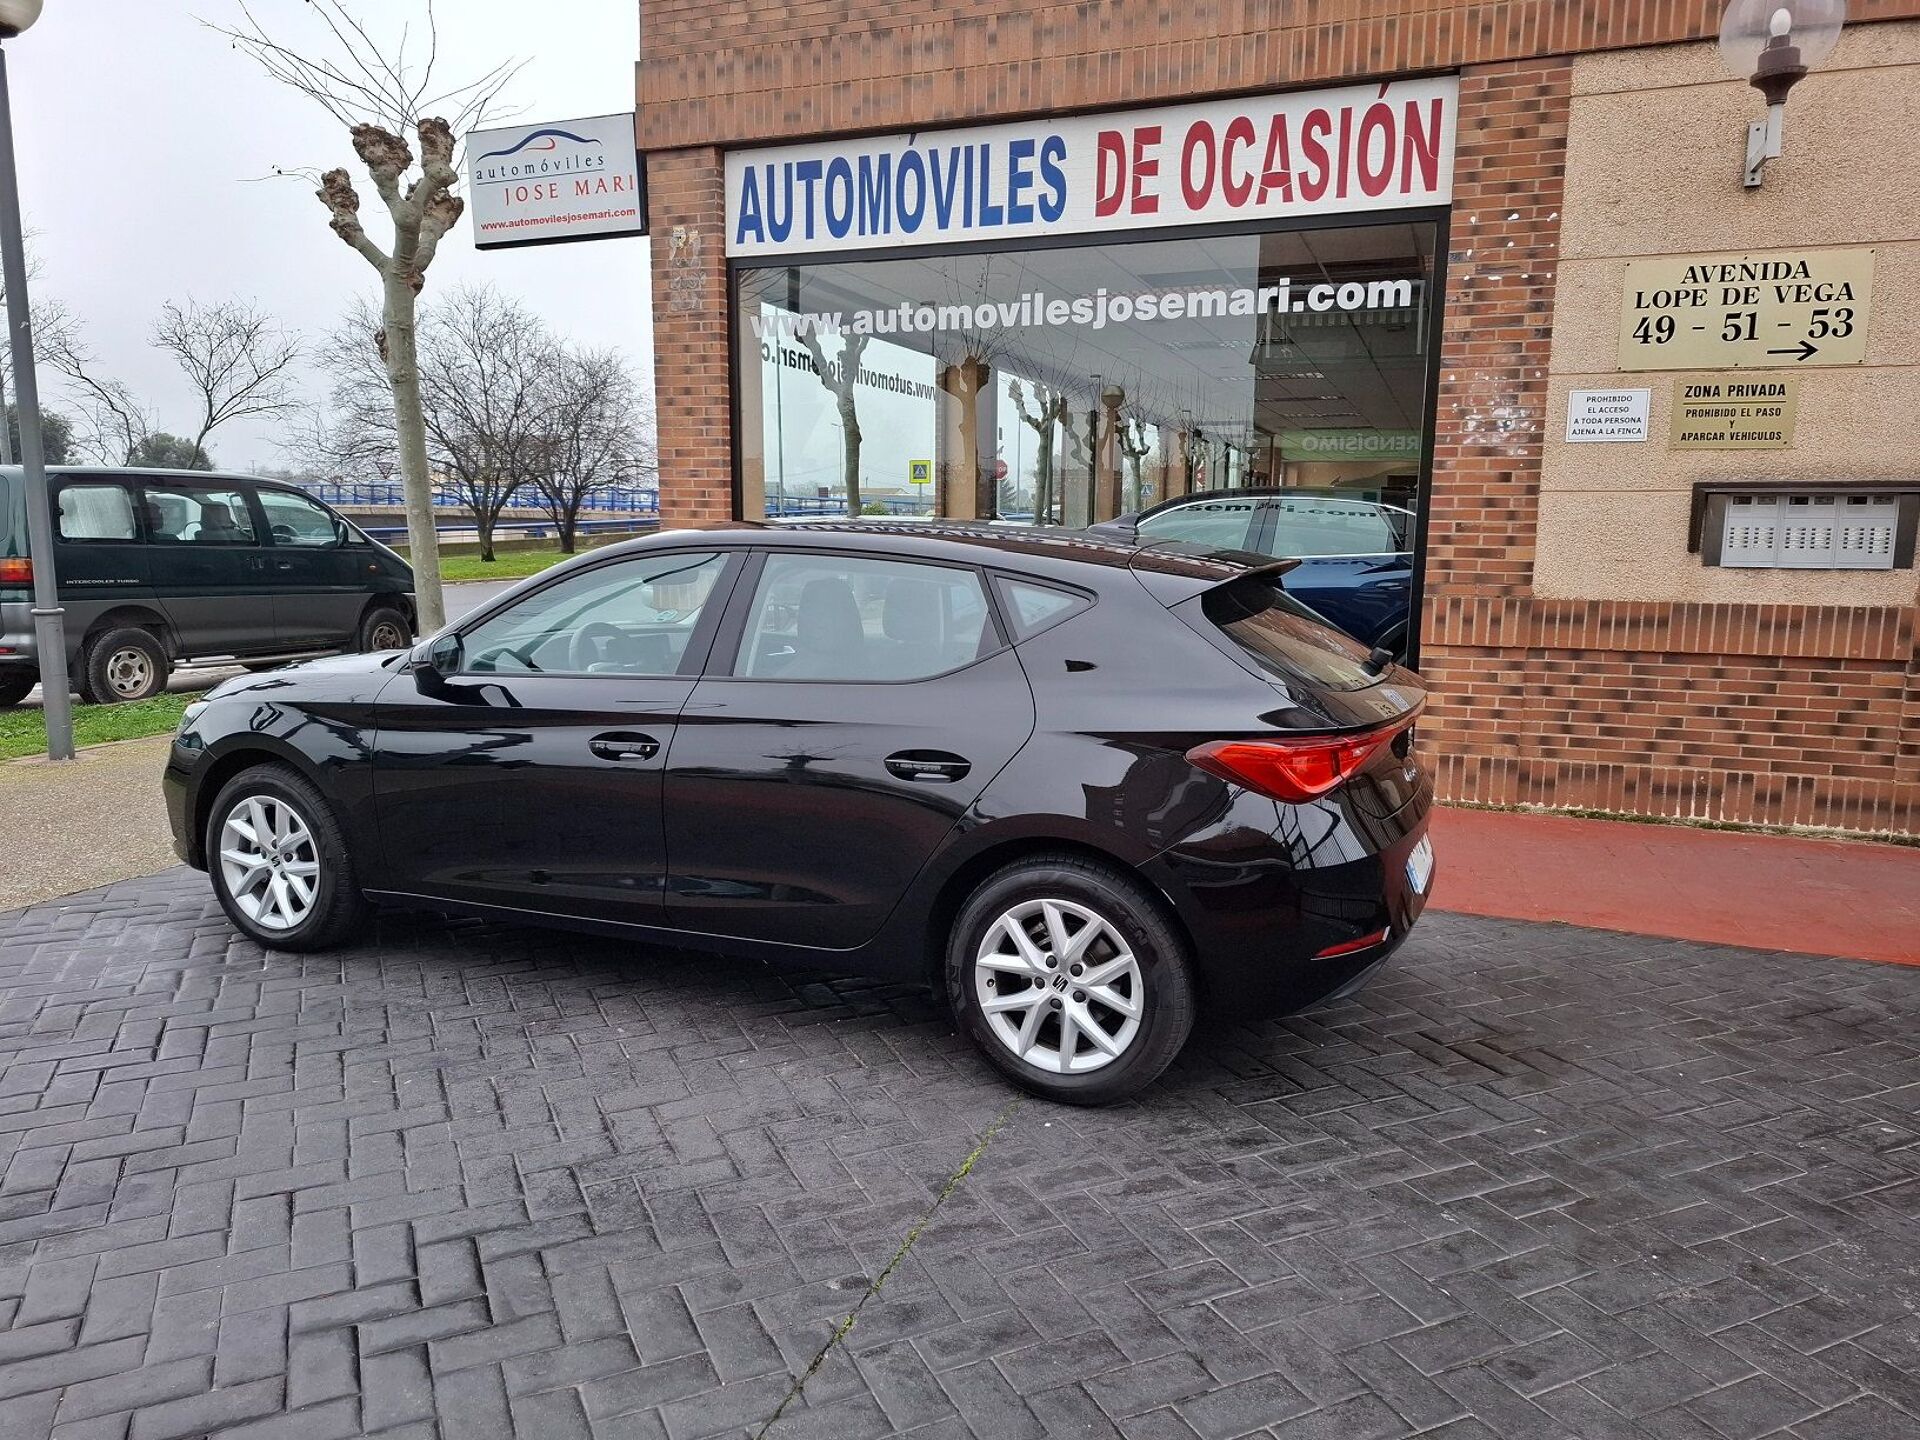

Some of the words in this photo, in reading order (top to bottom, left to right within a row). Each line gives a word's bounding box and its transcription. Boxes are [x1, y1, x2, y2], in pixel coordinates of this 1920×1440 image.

[475, 154, 605, 180] automóviles
[736, 132, 1067, 244] AUTOMÓVILES
[1095, 126, 1163, 218] DE
[1181, 82, 1444, 211] OCASIÓN
[505, 183, 559, 206] JOSE
[575, 174, 634, 196] MARI
[481, 208, 636, 231] www.automovilesjosemari.com
[1681, 260, 1811, 284] AVENIDA
[750, 276, 1413, 339] www.automovilesjosemari.com
[1634, 289, 1708, 309] LOPE
[1721, 286, 1761, 306] DE
[1774, 282, 1855, 304] VEGA
[1632, 315, 1676, 345] 49
[1721, 312, 1760, 342] 51
[1807, 308, 1854, 339] 53
[1586, 395, 1633, 403] PROHIBIDO
[1684, 385, 1720, 398] ZONA
[1728, 384, 1786, 397] PRIVADA
[1686, 408, 1736, 418] PROHIBIDO
[1741, 408, 1751, 417] EL
[1756, 407, 1781, 416] PASO
[1729, 420, 1735, 428] Y
[1680, 432, 1725, 441] APARCAR
[1730, 431, 1782, 440] VEHICULOS
